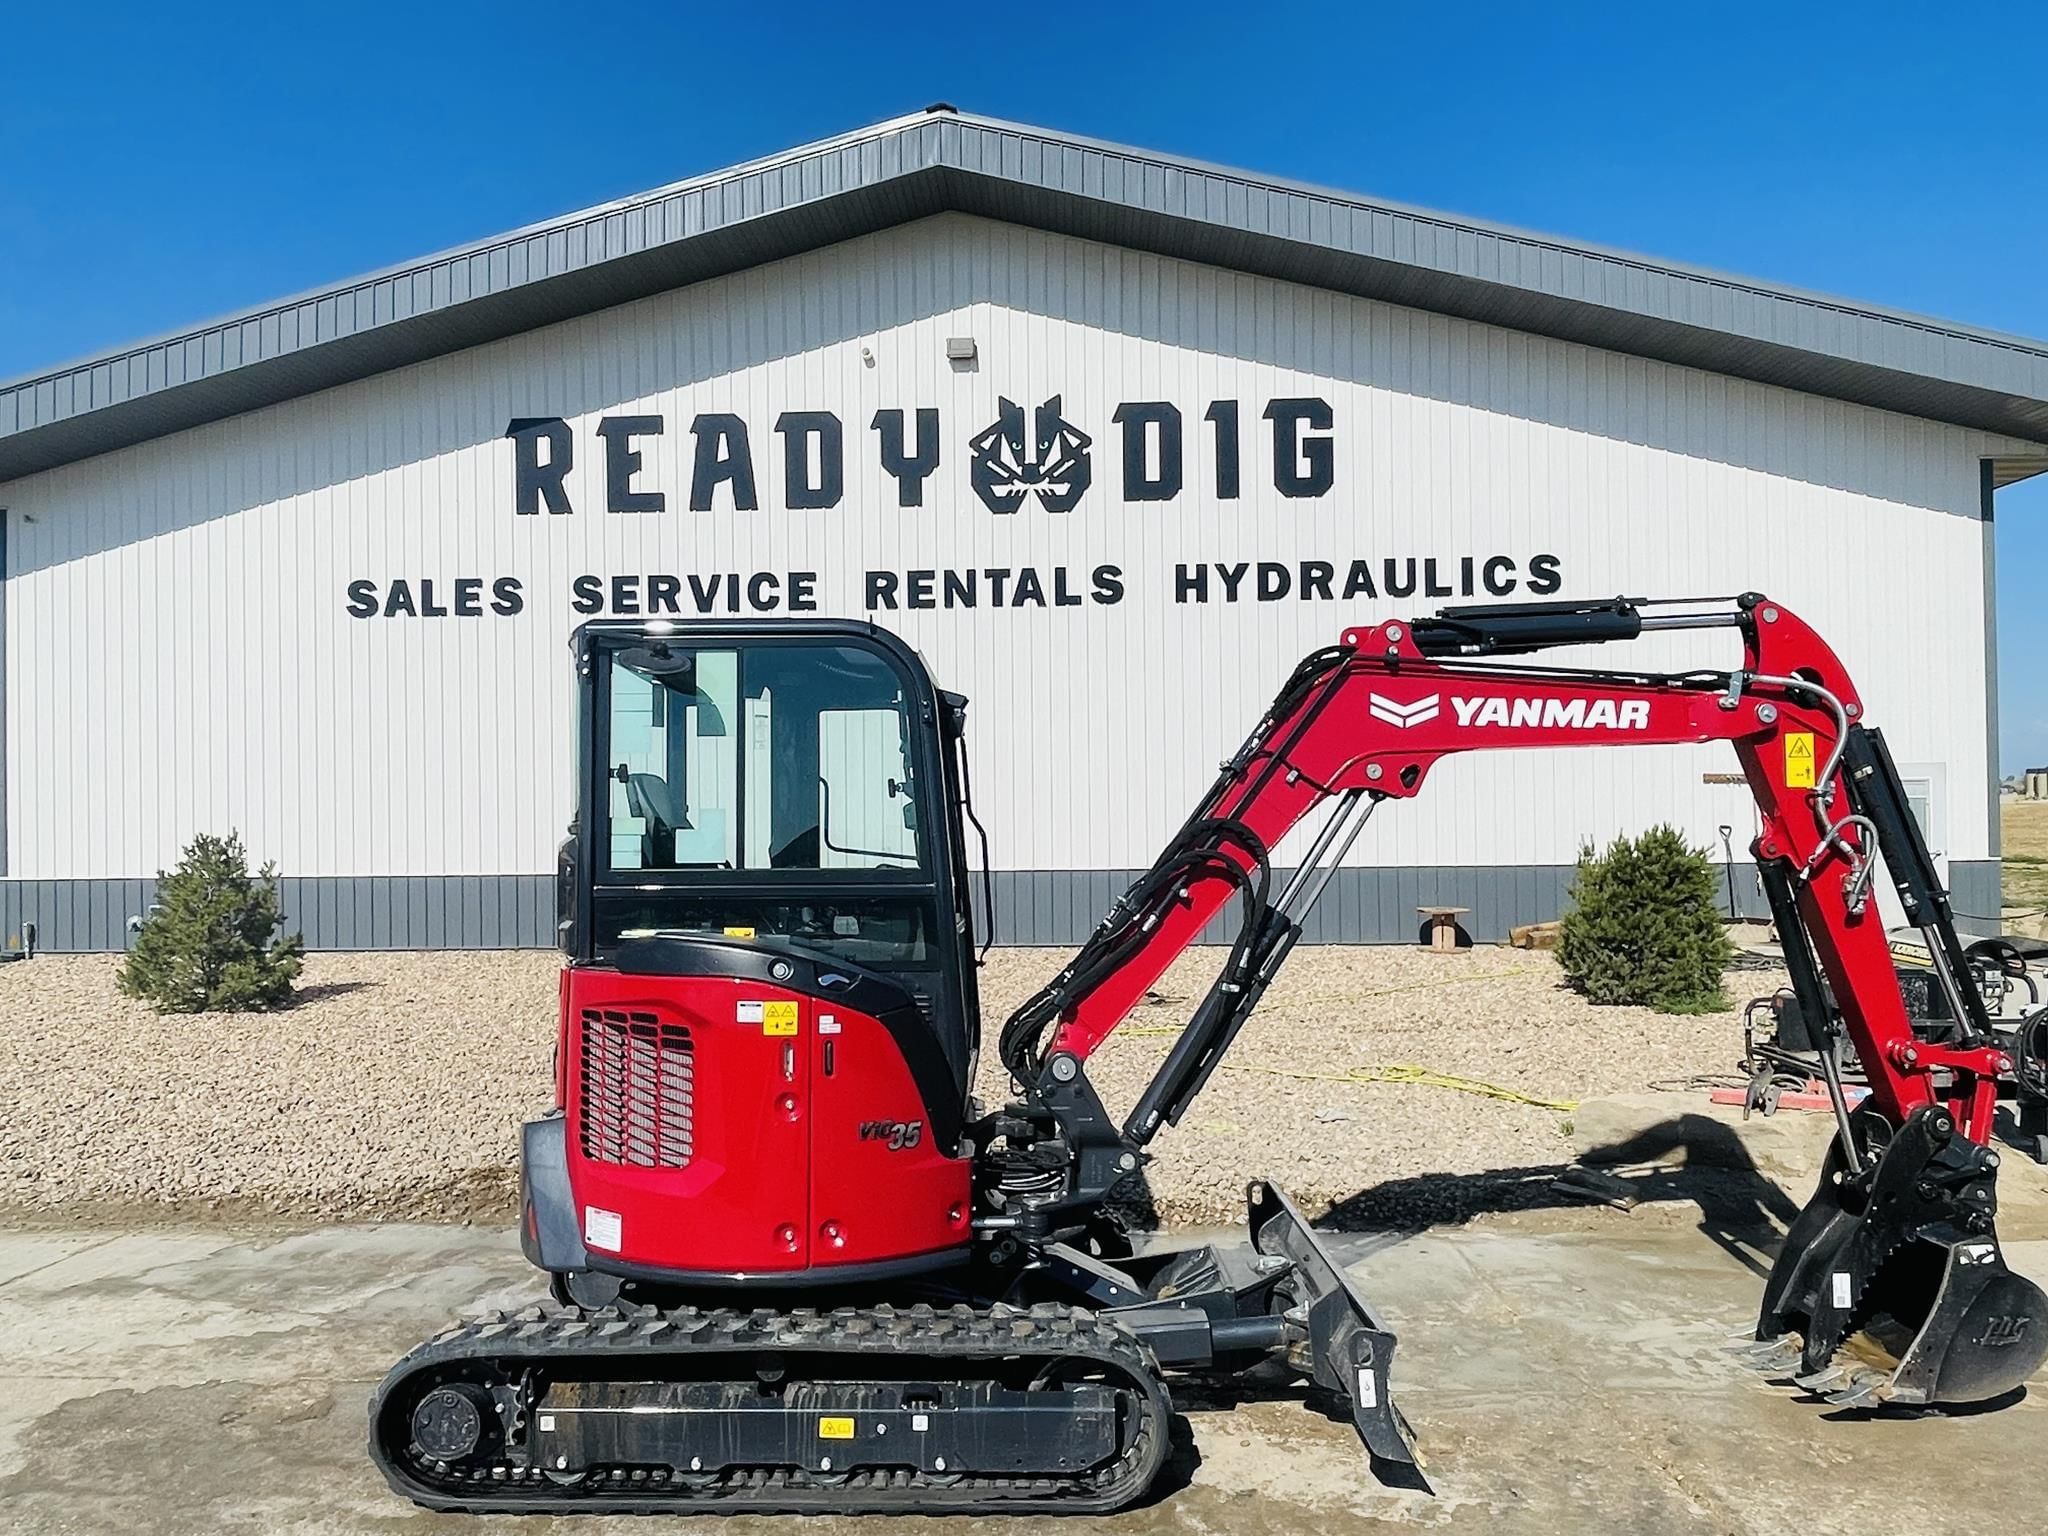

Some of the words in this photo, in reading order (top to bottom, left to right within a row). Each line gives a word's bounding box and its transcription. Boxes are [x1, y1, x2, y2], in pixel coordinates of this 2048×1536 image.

[504, 408, 940, 515] READY
[1111, 397, 1335, 502] DIG
[346, 577, 524, 619] SALES
[571, 571, 817, 615] SERVICE
[865, 564, 1125, 611] RENTALS
[1175, 554, 1562, 602] HYDRAULICS
[1449, 696, 1652, 731] YANMAR
